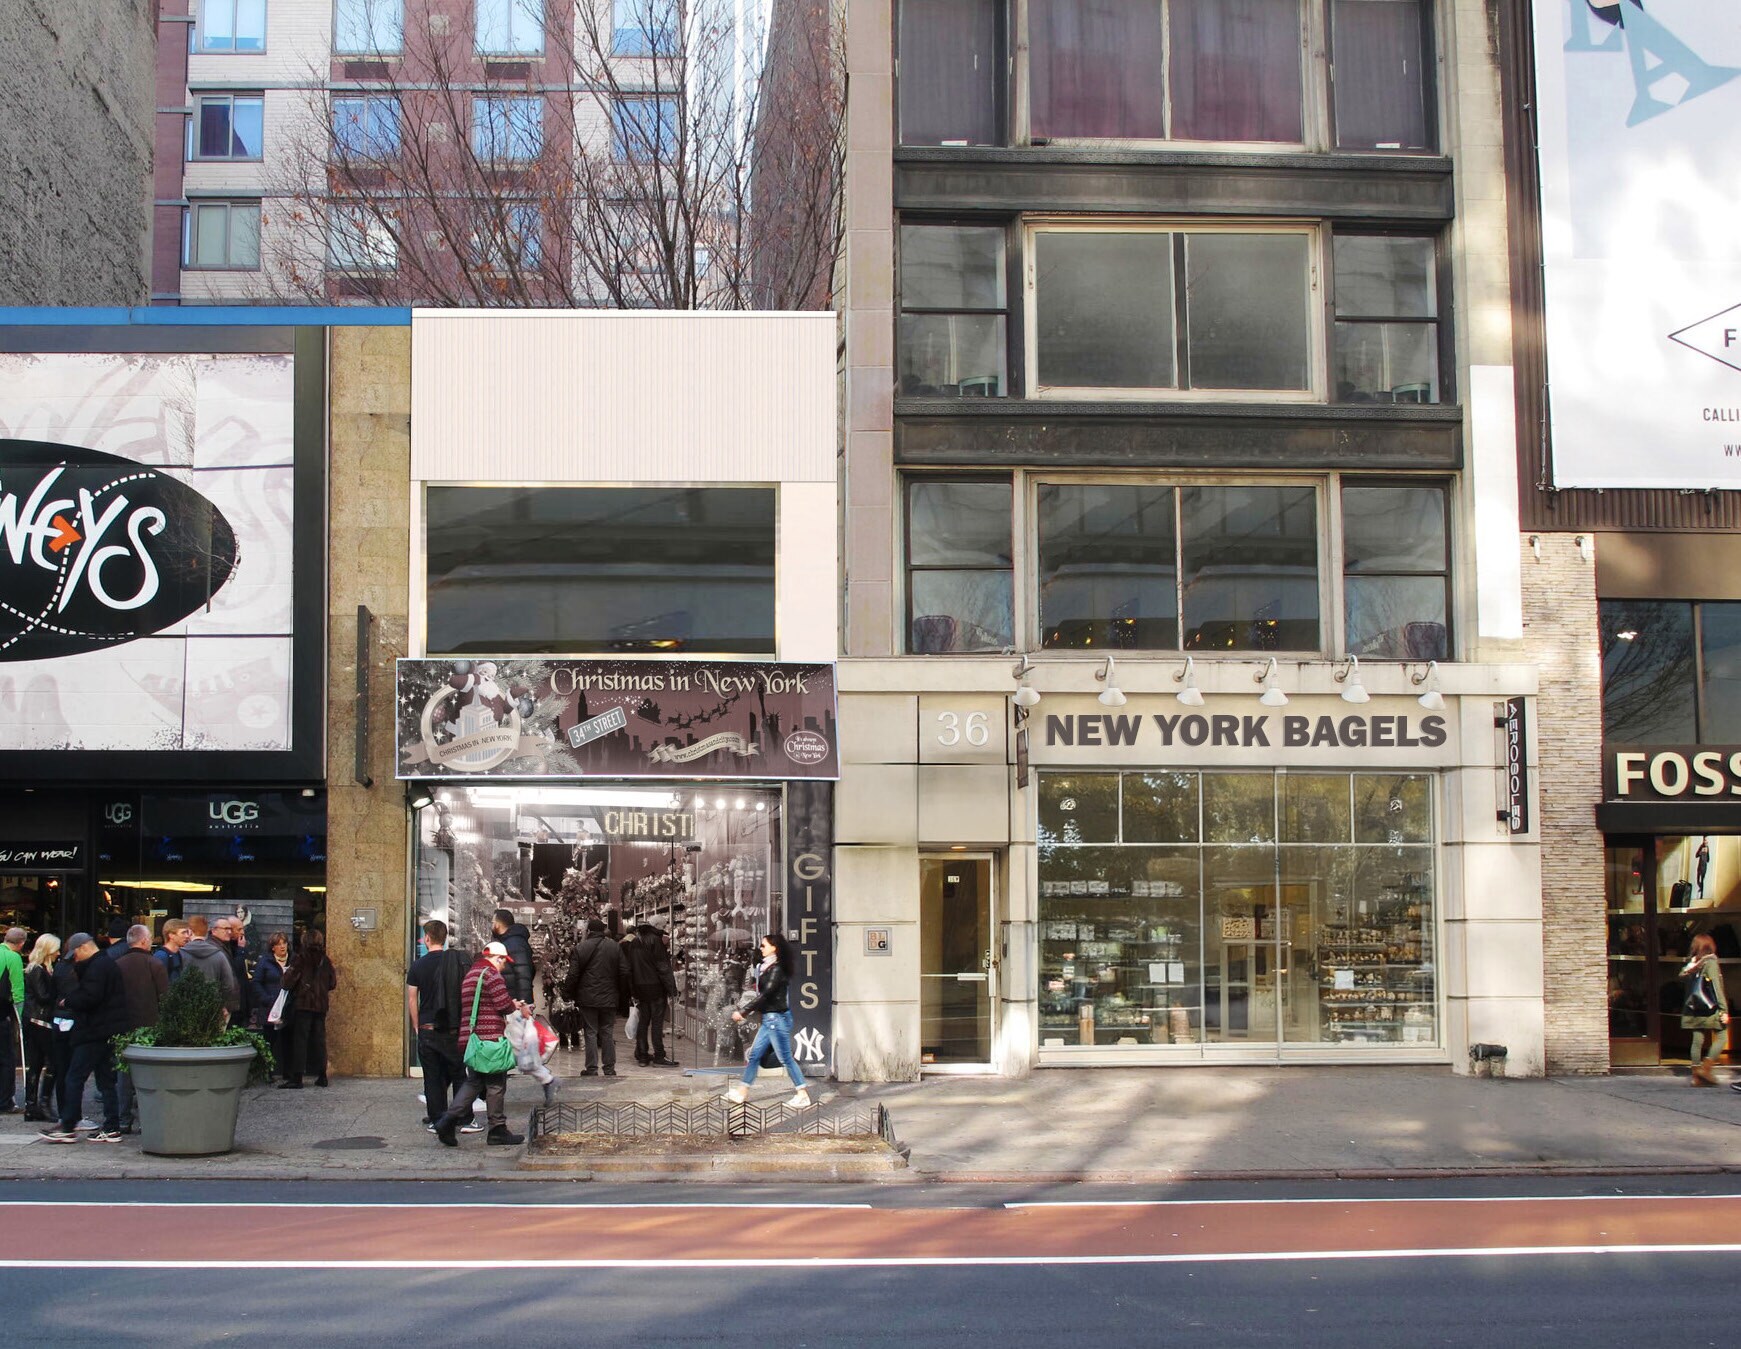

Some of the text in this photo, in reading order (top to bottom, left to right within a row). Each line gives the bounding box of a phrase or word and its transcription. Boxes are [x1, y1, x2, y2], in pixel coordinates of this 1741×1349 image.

[550, 668, 809, 699] Christmas in New York
[594, 711, 622, 735] STREET
[937, 710, 989, 746] 36
[1046, 714, 1447, 748] NEW YORK BAGELS
[439, 734, 513, 758] CHRISTMAS IN NEW YORK
[787, 742, 825, 752] Christmas
[1508, 702, 1521, 831] AEROSOLES
[105, 802, 132, 823] UGG
[208, 800, 259, 824] UGG
[793, 853, 825, 1010] GIFTS
[793, 1026, 825, 1062] NY
